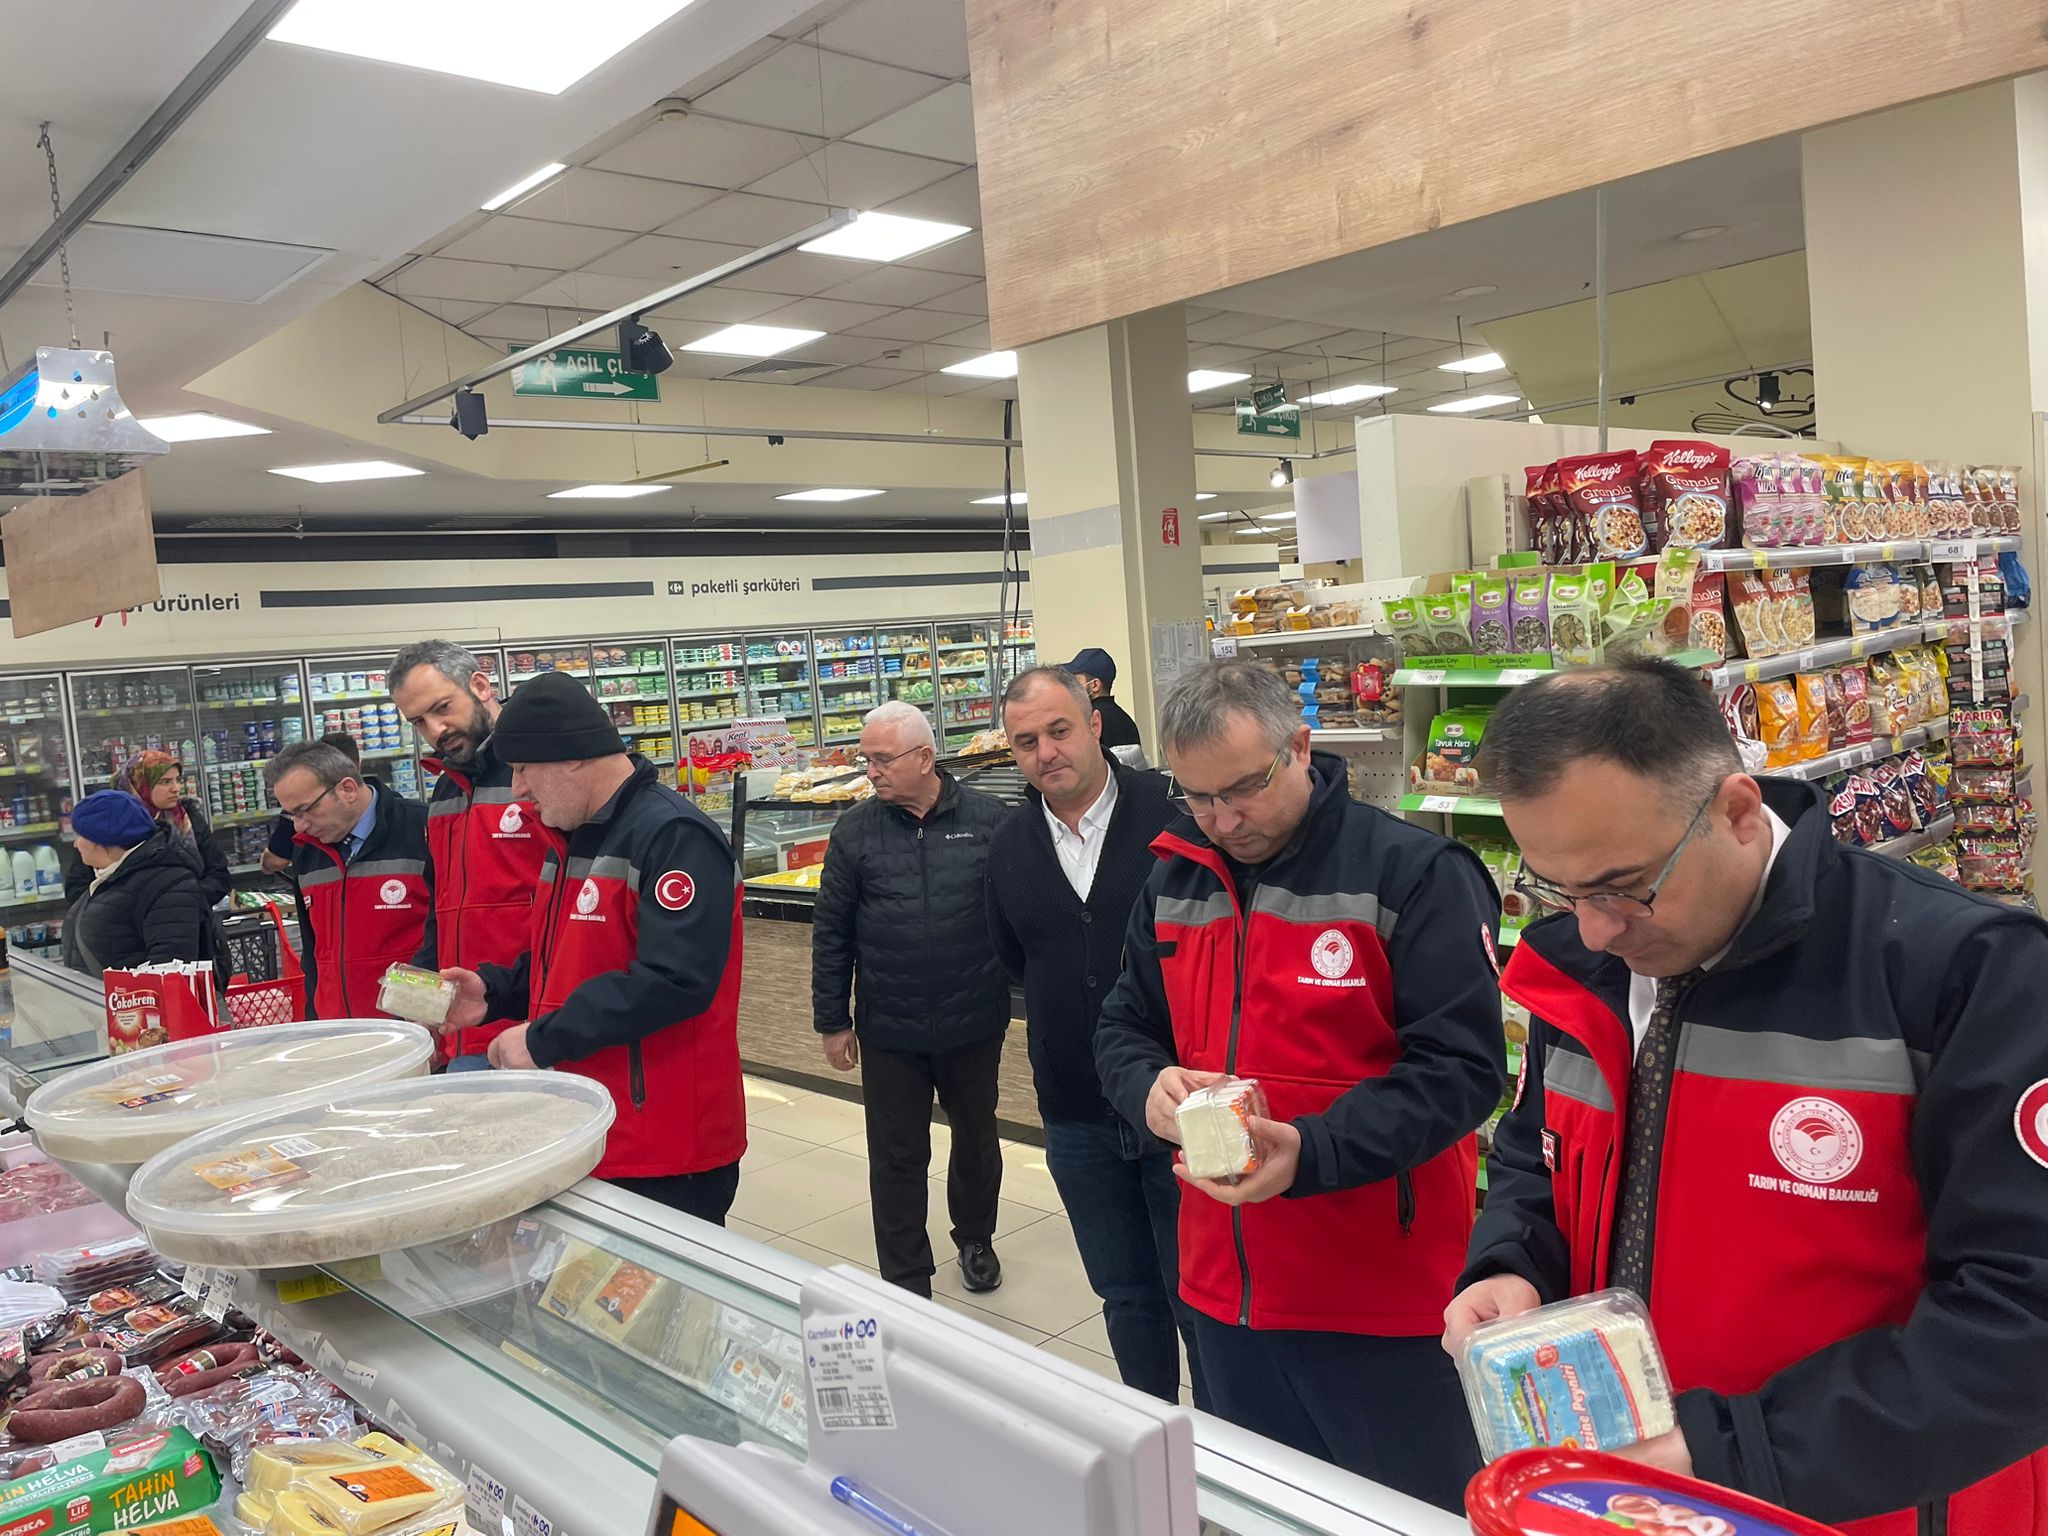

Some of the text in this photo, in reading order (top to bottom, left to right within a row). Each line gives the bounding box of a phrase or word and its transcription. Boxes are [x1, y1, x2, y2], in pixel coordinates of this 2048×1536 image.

[566, 354, 603, 373] ACİL
[1663, 449, 1717, 469] Kellogg's
[1575, 463, 1623, 482] Kellogg's
[1666, 474, 1721, 488] Granola
[1581, 484, 1632, 499] Granola
[691, 578, 800, 597] paketli şarküteri
[153, 593, 240, 612] ürünleri
[1220, 645, 1233, 654] 152
[1954, 709, 2004, 722] HARIBO
[727, 731, 747, 742] Kent
[1435, 739, 1453, 748] Tavuk
[109, 992, 156, 1016] Çokokrem
[1748, 1174, 1879, 1203] TARIM VE ORMAN BAKANLIĞI
[1560, 1364, 1599, 1450] Ezine Peyniri
[27, 1464, 89, 1491] HELVA
[109, 1470, 175, 1509] TAHİN
[71, 1504, 88, 1517] LIF
[114, 1489, 180, 1530] HELVA
[1, 1519, 46, 1536] OSKA
